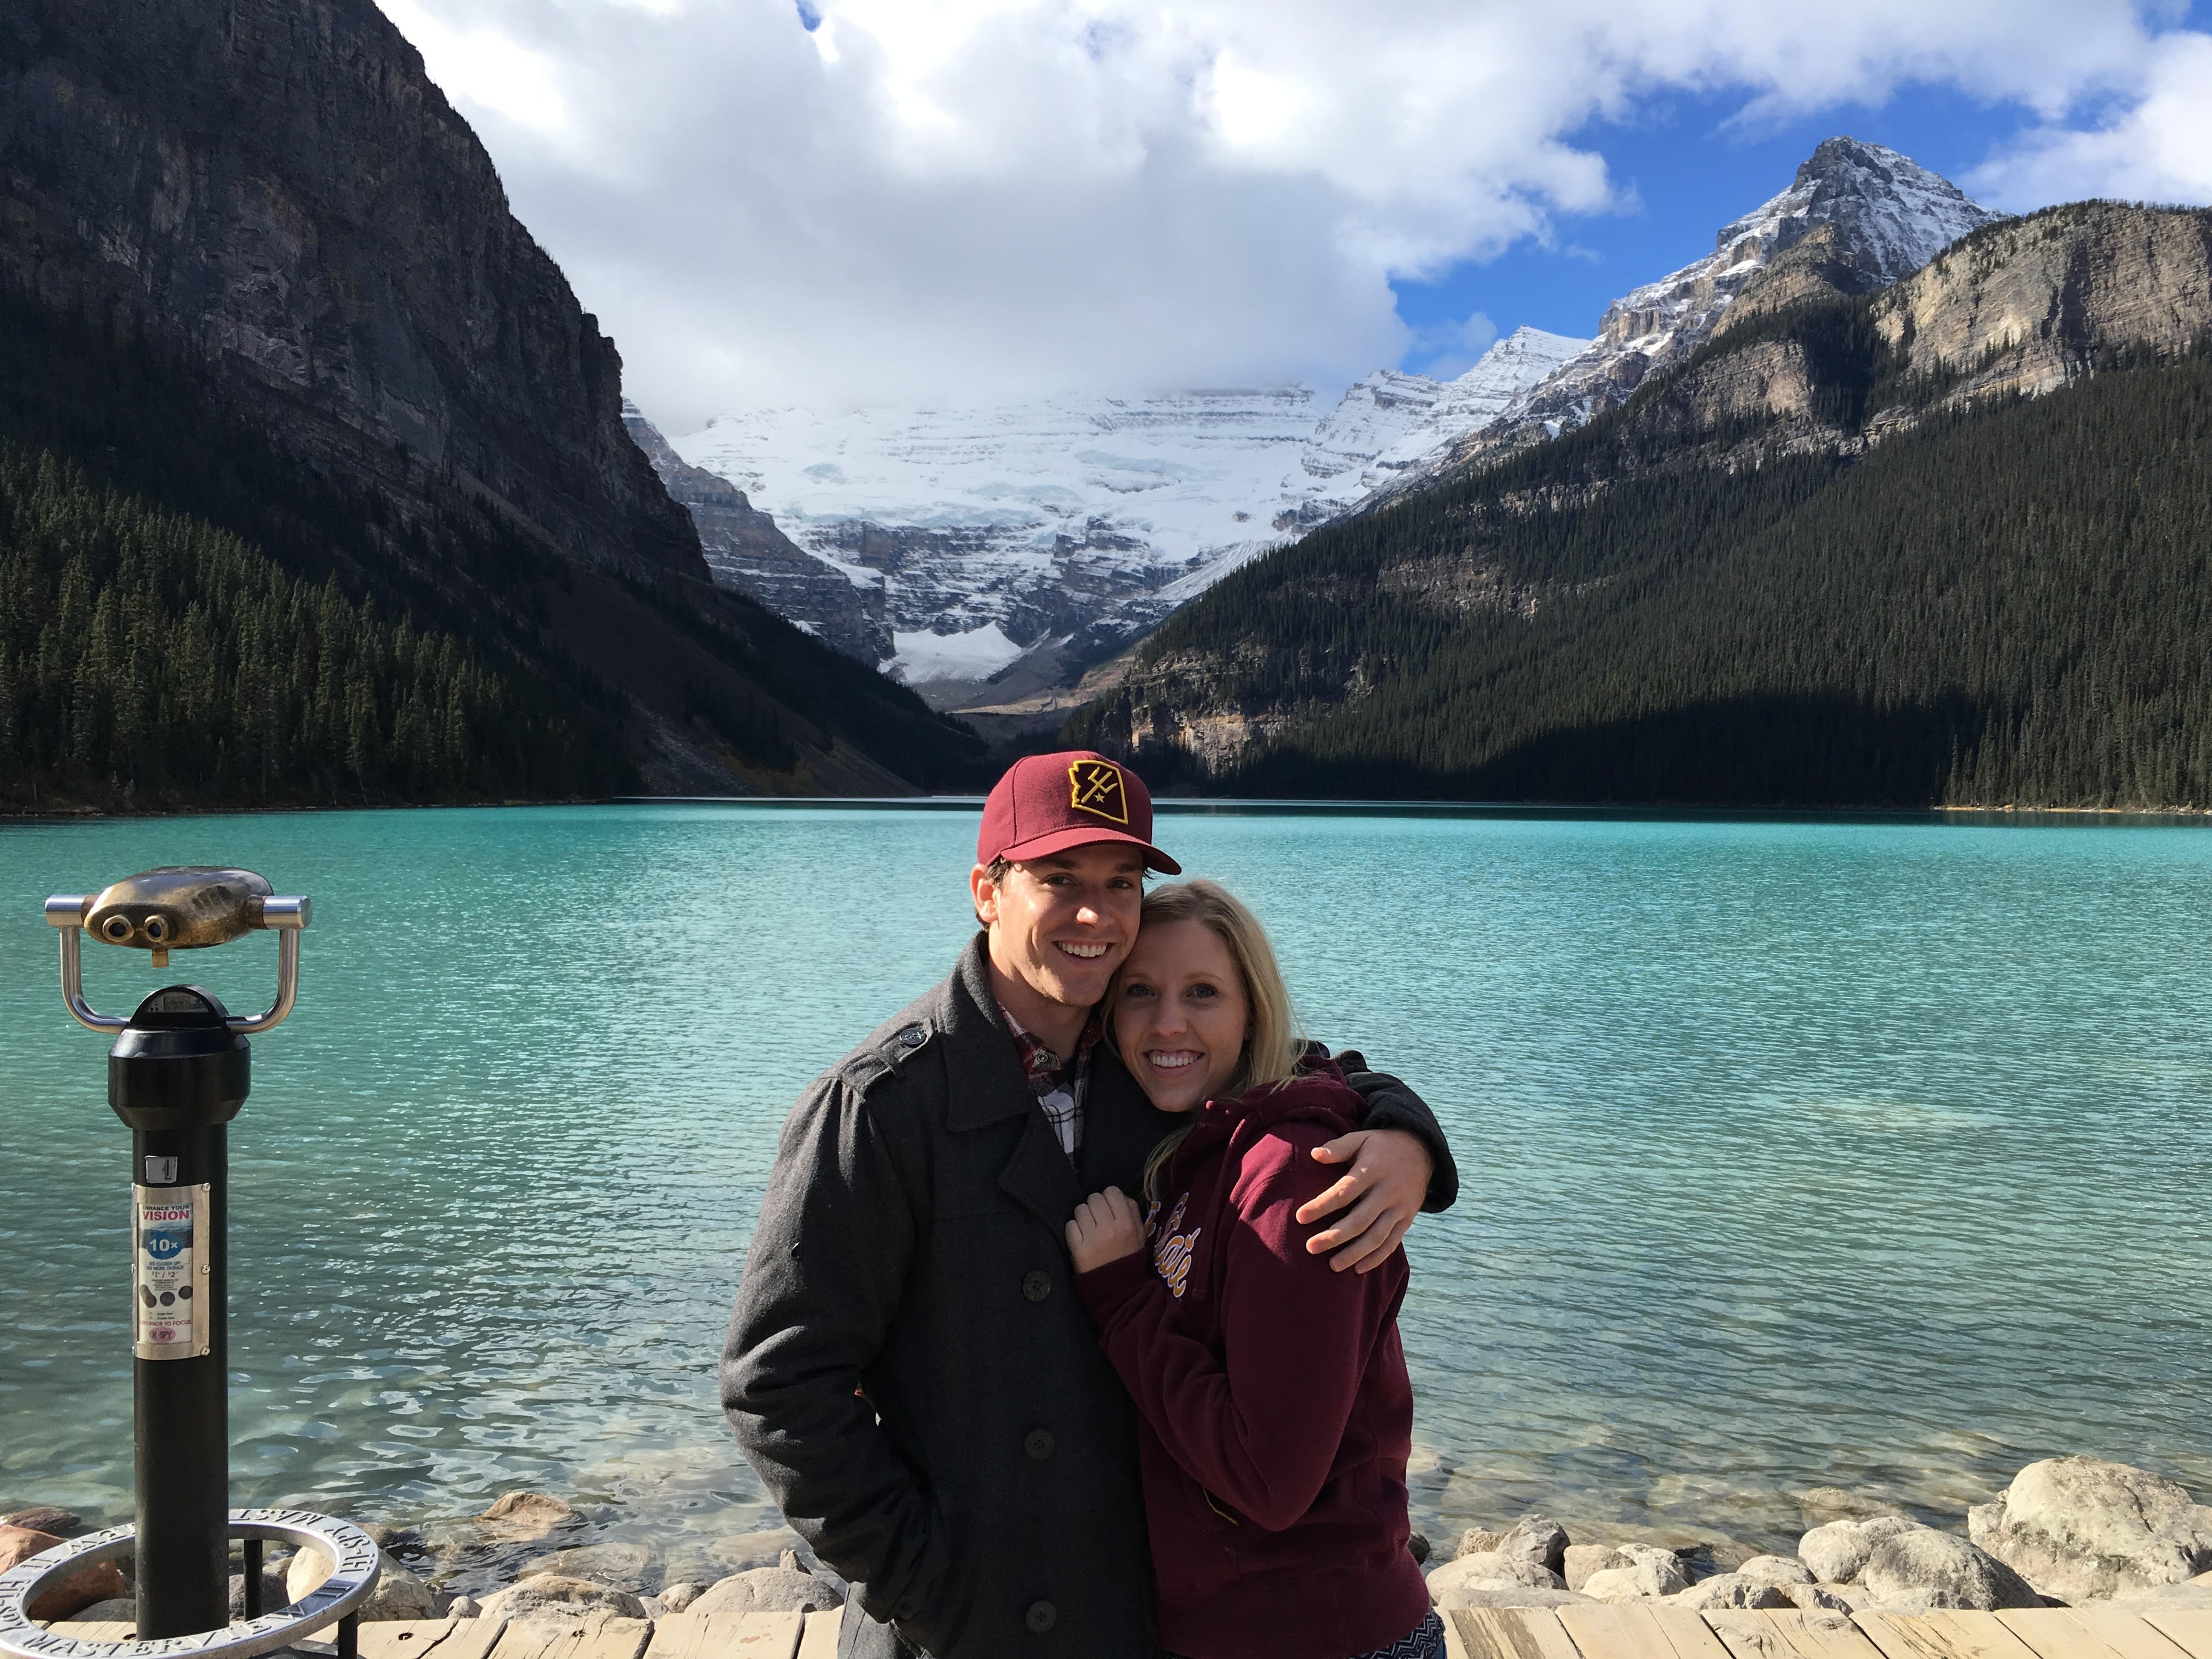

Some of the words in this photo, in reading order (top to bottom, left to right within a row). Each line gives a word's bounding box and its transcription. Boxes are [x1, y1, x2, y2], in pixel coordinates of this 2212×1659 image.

[143, 1210, 190, 1221] VISION
[150, 1238, 178, 1252] 10x
[320, 1525, 376, 1574] HI-SPY
[16, 1603, 305, 1657] MASTERVIEW
